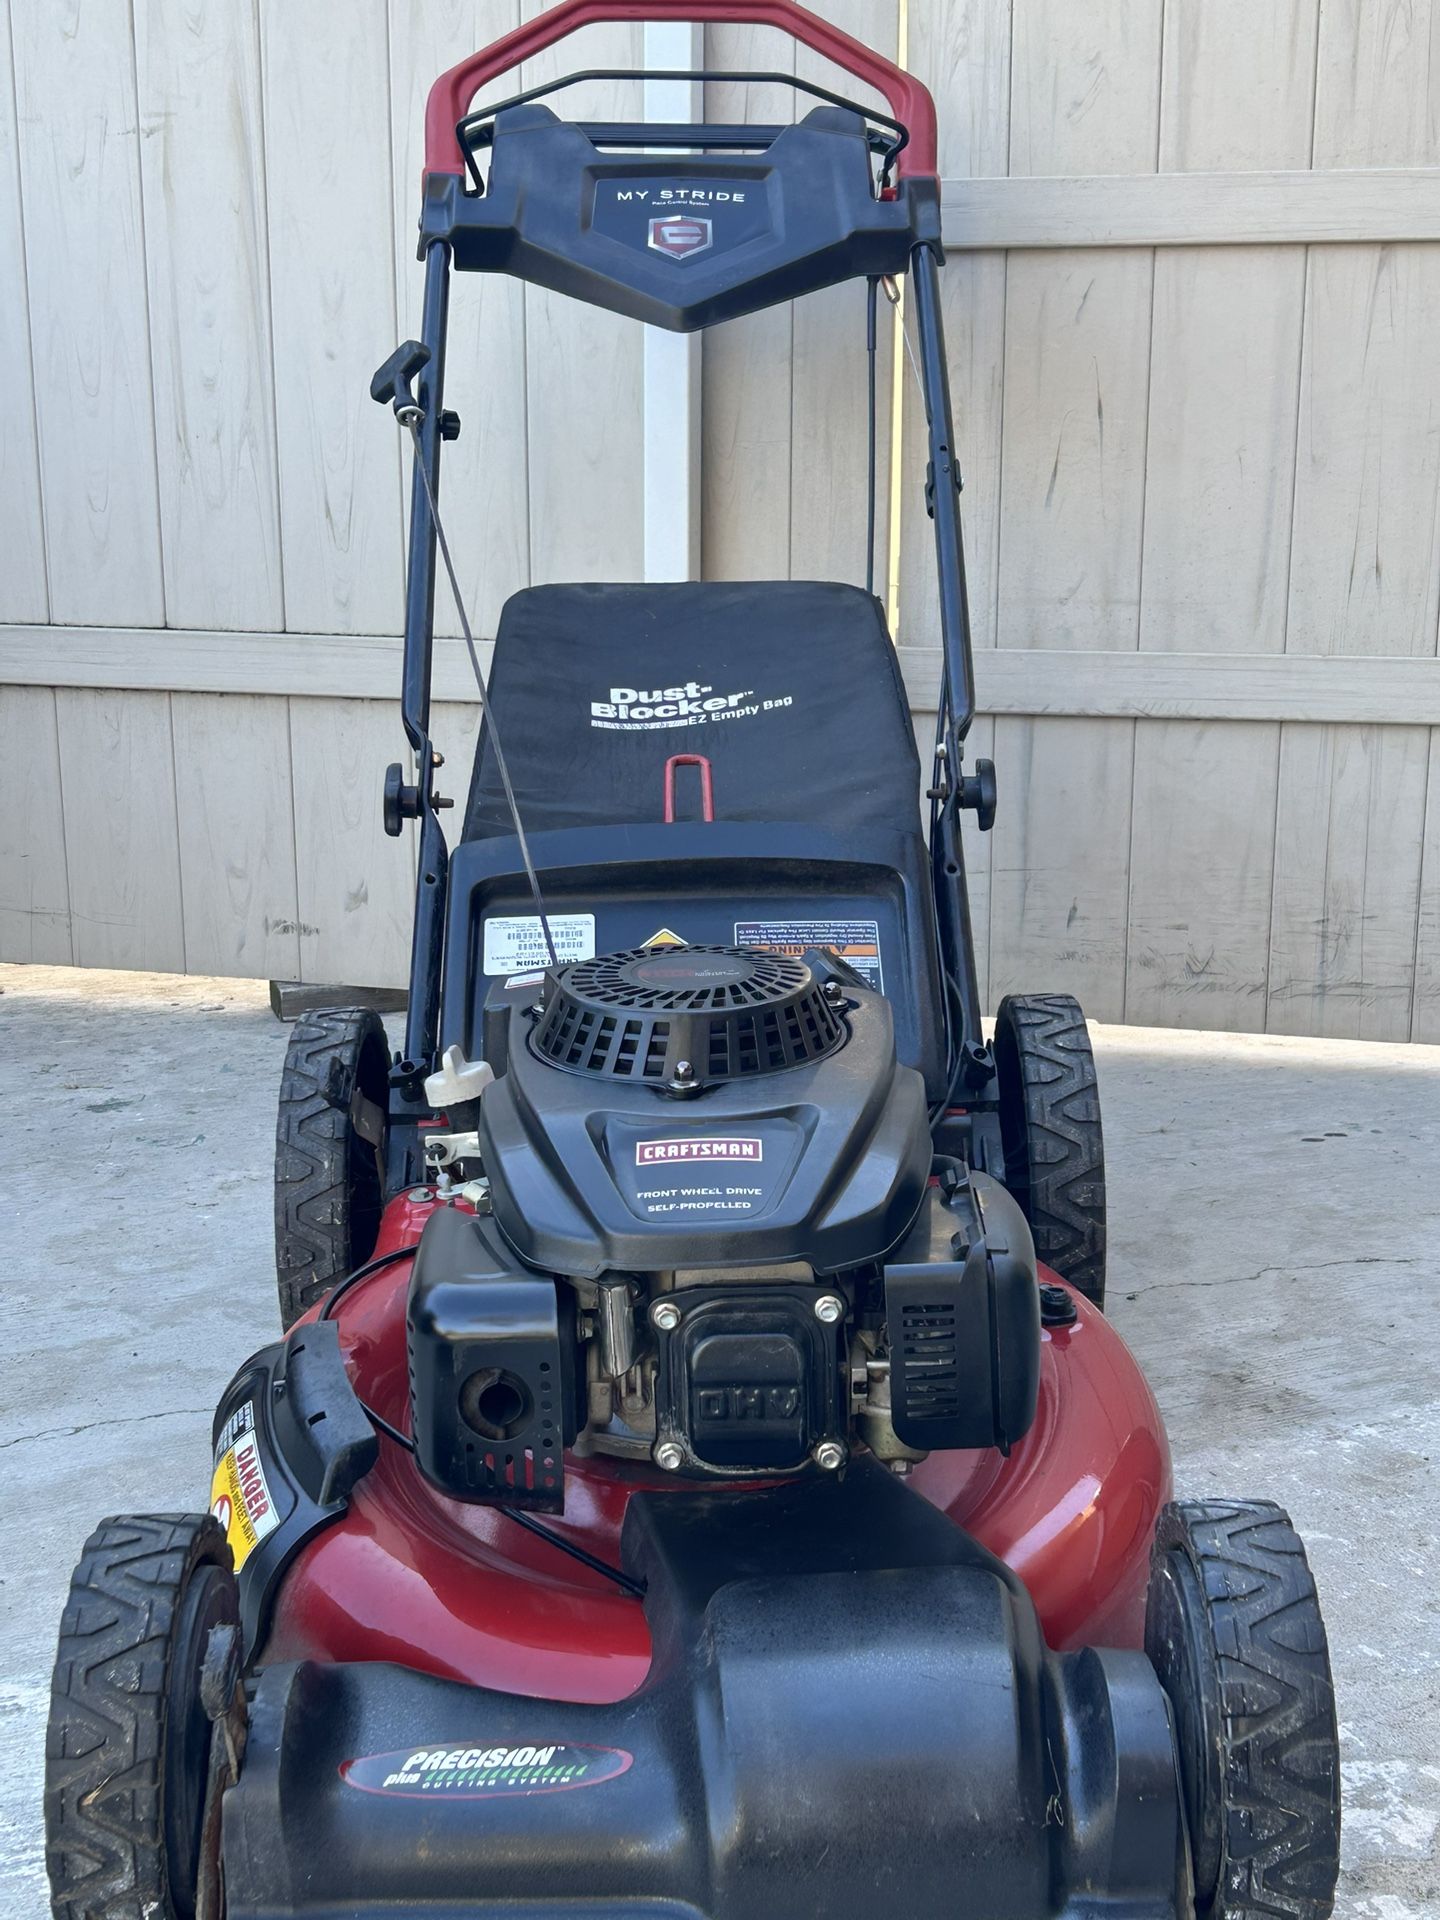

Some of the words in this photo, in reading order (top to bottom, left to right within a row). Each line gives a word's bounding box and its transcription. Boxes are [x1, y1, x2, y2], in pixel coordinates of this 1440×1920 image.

[617, 191, 649, 201] MY
[660, 190, 745, 202] STRIDE
[609, 681, 712, 704] Dust-
[688, 715, 707, 726] EZ
[711, 704, 759, 722] Empty
[763, 695, 793, 711] Bag
[644, 1143, 754, 1160] CRAFTSMAN
[637, 1189, 678, 1199] FRONT
[680, 1187, 723, 1196] WHEEL
[726, 1187, 763, 1196] DRIVE
[647, 1201, 752, 1212] SELF-PROPELLED
[699, 1388, 799, 1421] OHV
[237, 1444, 269, 1524] DANGER
[241, 1521, 256, 1546] AWAY
[401, 1746, 556, 1771] PRECISION
[383, 1772, 421, 1787] plus
[508, 1776, 571, 1785] SYSTEM
